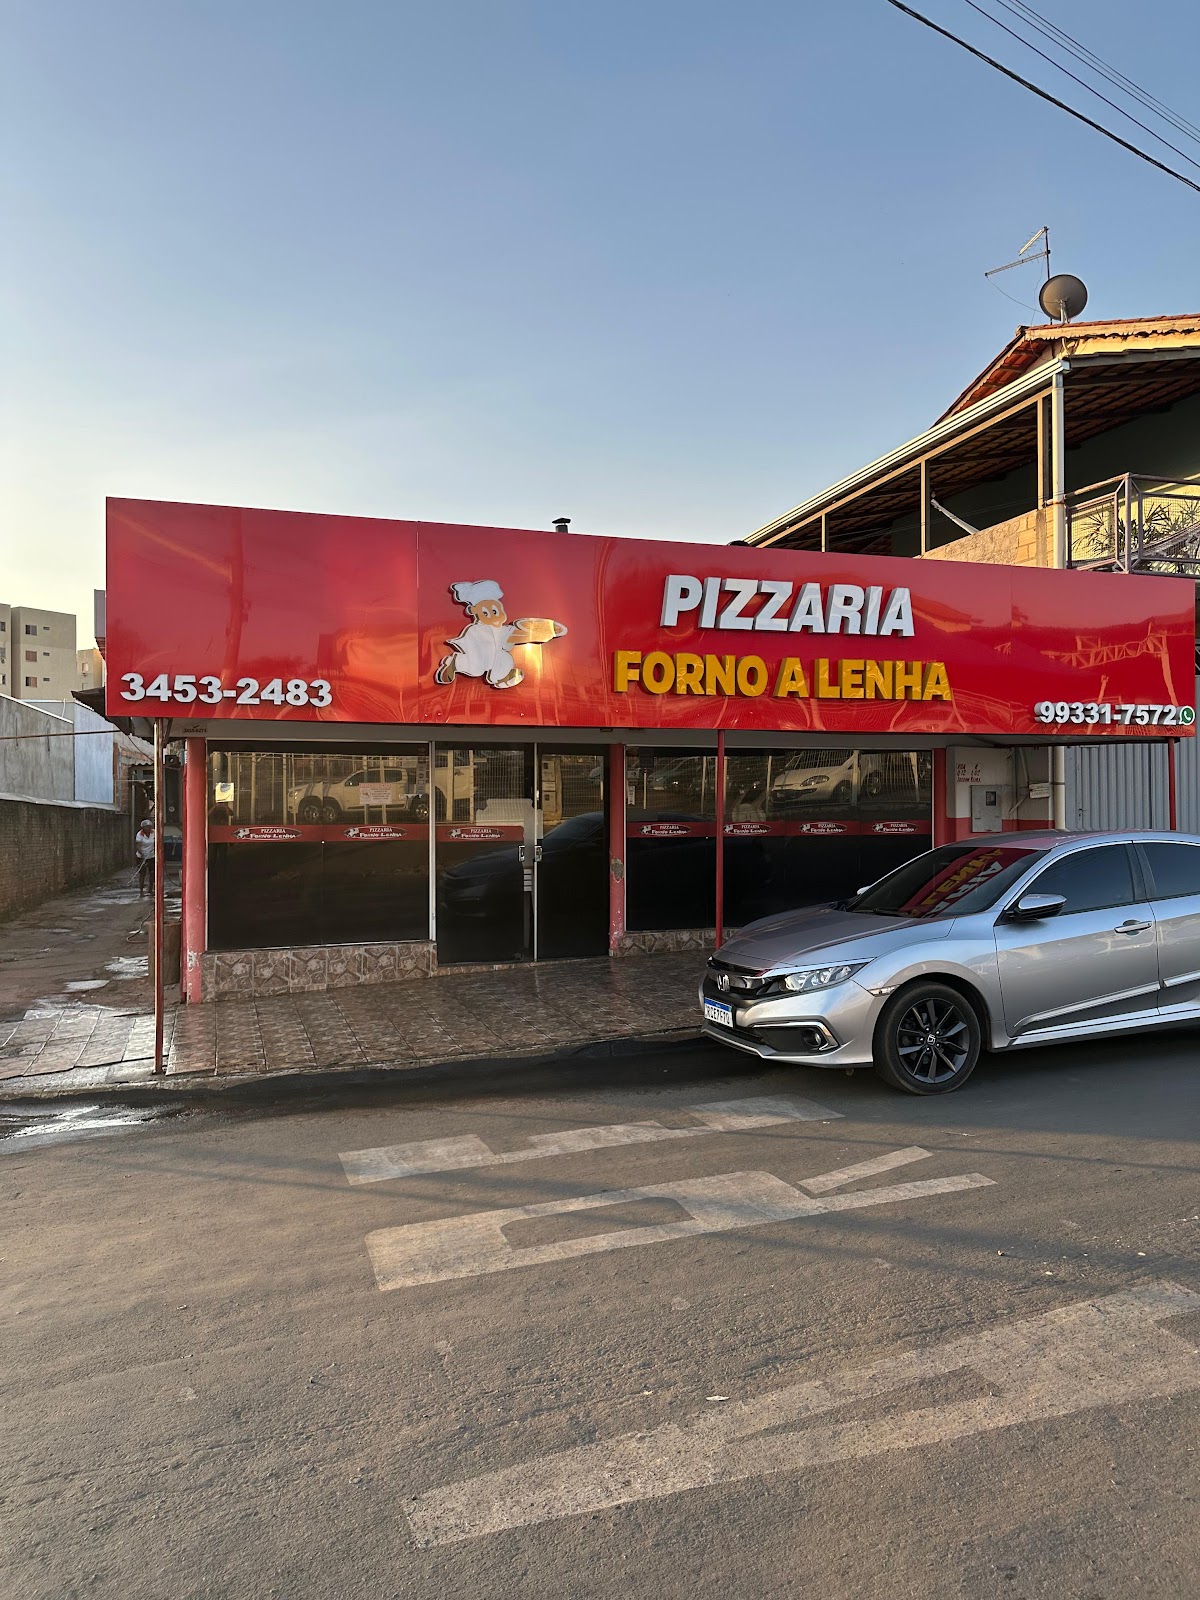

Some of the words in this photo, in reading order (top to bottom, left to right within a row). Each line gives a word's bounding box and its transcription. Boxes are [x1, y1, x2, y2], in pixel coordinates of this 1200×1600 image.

[660, 574, 915, 637] PIZZARIA
[119, 672, 333, 707] 3453-2483
[614, 650, 769, 698] FORNO
[772, 657, 809, 698] A
[813, 658, 952, 701] LENHA
[1034, 701, 1177, 726] 99331-7572
